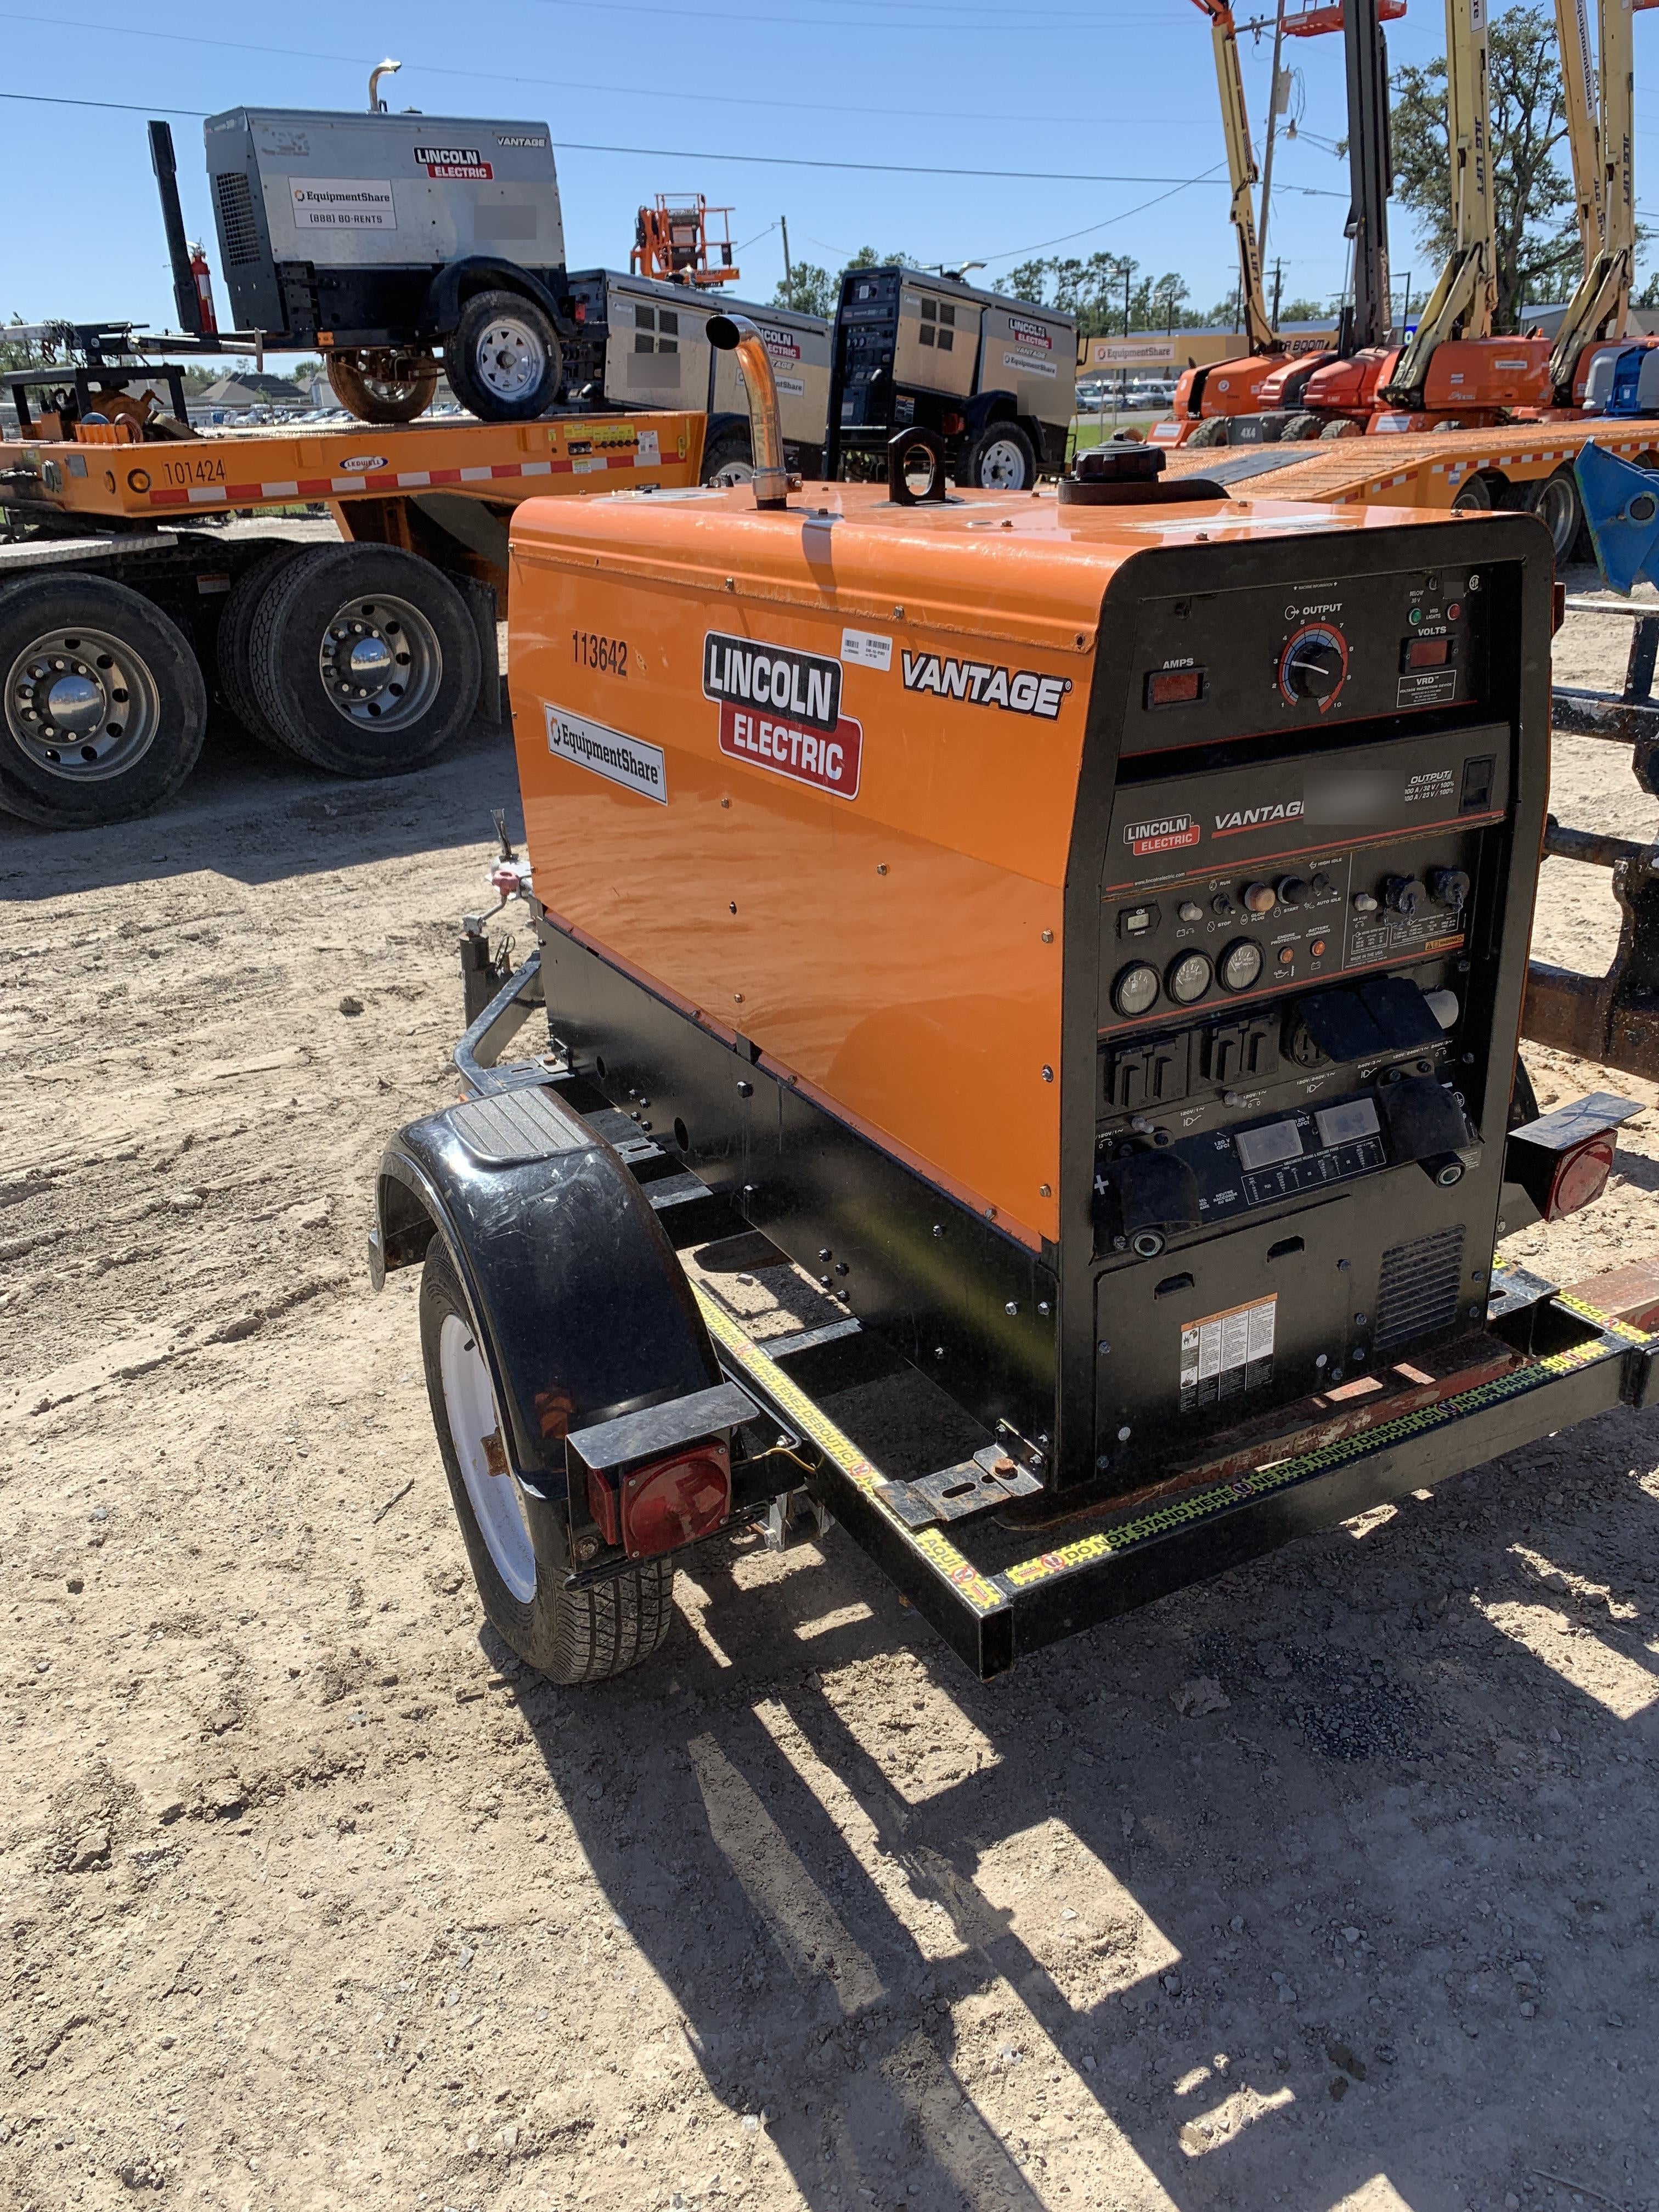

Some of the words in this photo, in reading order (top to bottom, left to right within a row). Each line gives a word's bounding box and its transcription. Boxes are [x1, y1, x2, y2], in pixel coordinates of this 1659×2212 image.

[498, 137, 545, 147] VANTAGE
[417, 149, 477, 165] LINCOLN
[434, 166, 487, 178] ELECTRIC
[306, 191, 390, 203] EquipmentShare
[1009, 319, 1045, 337] LINCOLN
[760, 329, 791, 345] NCOLN
[1018, 334, 1049, 347] ELECTRIC
[768, 344, 797, 357] ECTRIC
[1017, 347, 1046, 358] VANTAGE
[1108, 347, 1171, 359] EquipmentShare
[771, 360, 793, 369] TAGE
[1011, 357, 1055, 374] EquipmentShare
[164, 459, 225, 484] 101424
[1302, 603, 1342, 615] OUTPUT
[1418, 626, 1447, 636] VOLTS
[572, 630, 628, 676] 113642
[1163, 658, 1194, 669] AMPS
[710, 644, 832, 721] LINCOLN
[904, 653, 1063, 716] VANTAGE
[733, 713, 844, 780] ELECTRIC
[561, 723, 659, 785] EquipmentShare
[1410, 770, 1450, 784] OUTPUT
[1215, 800, 1304, 830] VANTAG
[1127, 818, 1187, 840] LINCOLN
[1141, 833, 1192, 851] ELECTRIC
[1134, 872, 1185, 886] www.lincolnelectric.com
[1277, 932, 1295, 940] ENGINE
[1306, 928, 1330, 938] CHARGING
[1308, 925, 1329, 933] BATTERY
[1271, 935, 1301, 946] PROTECTION
[697, 1299, 722, 1324] STAND
[719, 1323, 743, 1345] HERE
[747, 1353, 761, 1366] NE
[761, 1364, 779, 1383] PAS
[775, 1381, 808, 1411] TENEZ
[801, 1409, 844, 1451] DEBOUT
[837, 1449, 857, 1464] ICI
[1064, 1545, 1092, 1560] DO
[1096, 1530, 1129, 1549] NOT
[1131, 1508, 1189, 1534] STAND
[1190, 1491, 1234, 1511] HERE
[1252, 1474, 1277, 1486] NE
[1276, 1462, 1305, 1478] PAS
[1306, 1442, 1359, 1468] TENEZ
[1356, 1418, 1418, 1445] DEBOUT
[1420, 1410, 1441, 1425] ICI
[1454, 1395, 1477, 1407] NO
[1477, 1386, 1499, 1398] SE
[1499, 1372, 1534, 1389] PARE
[1014, 1566, 1036, 1577] LINCOLN
